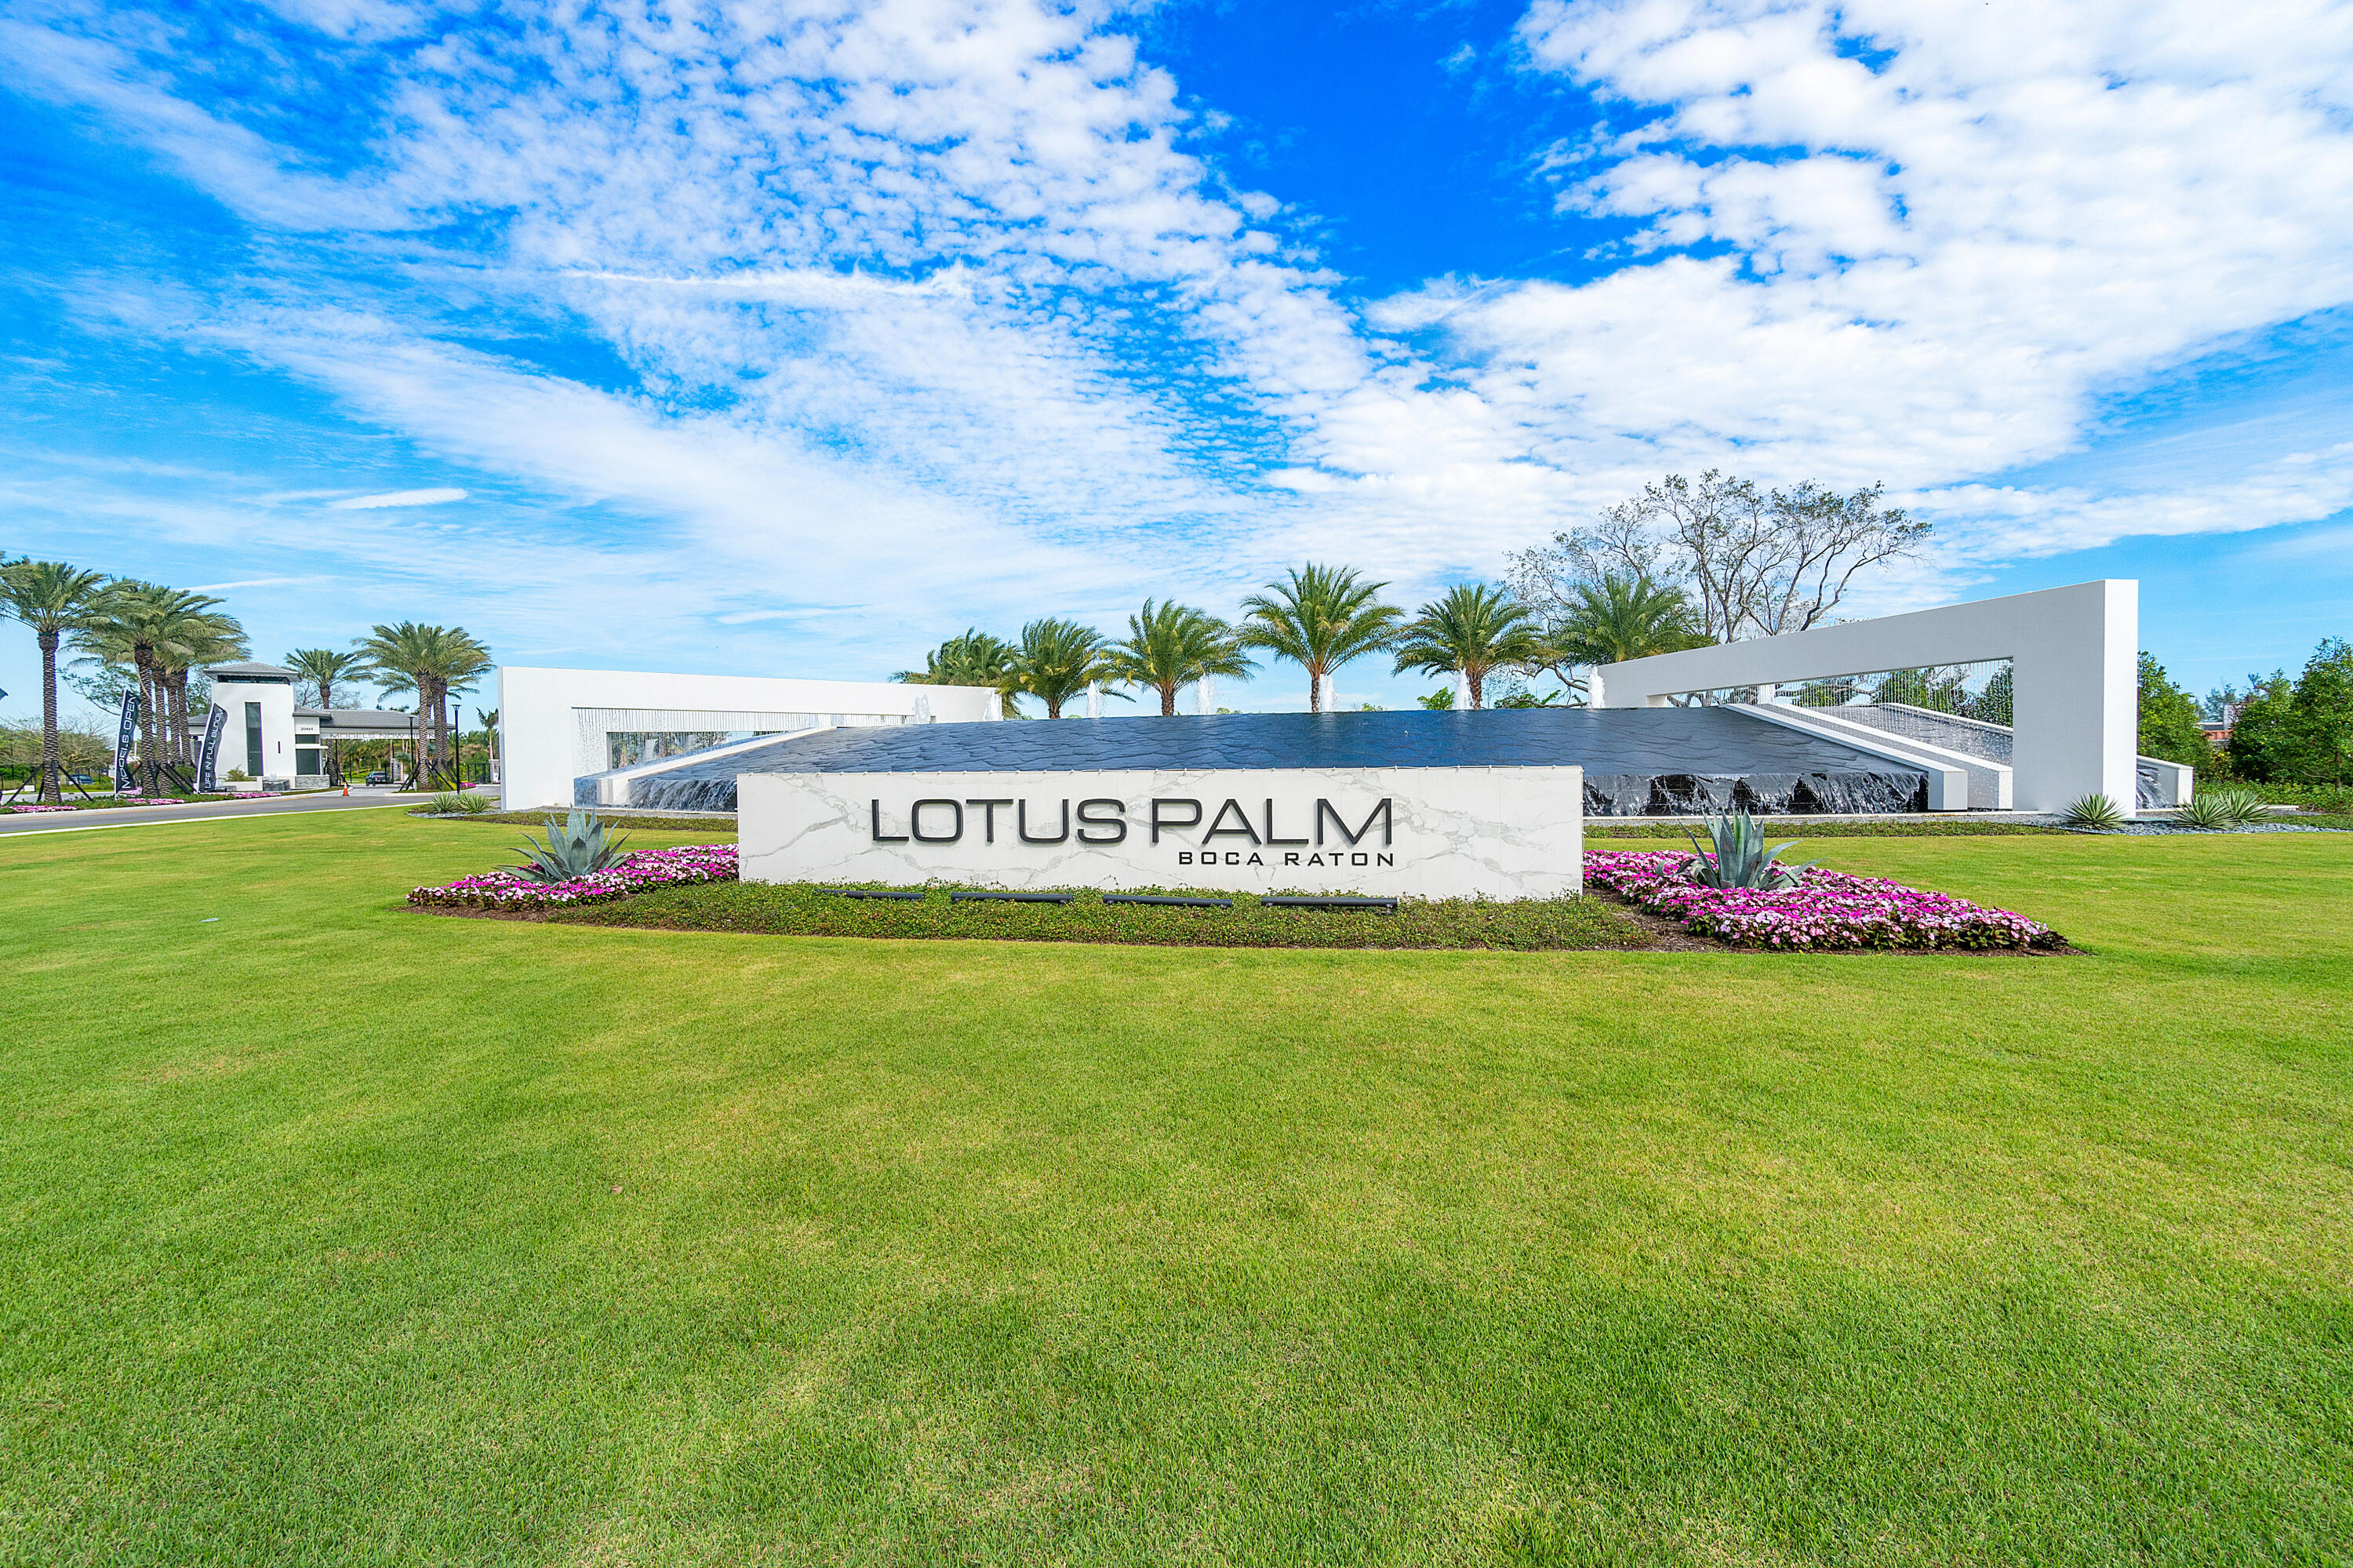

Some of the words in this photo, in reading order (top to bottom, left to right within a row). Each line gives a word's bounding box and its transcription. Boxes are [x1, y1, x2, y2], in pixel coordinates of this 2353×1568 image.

[123, 693, 136, 730] OPEN
[118, 734, 131, 789] MODELS
[205, 740, 216, 762] FULL
[205, 761, 212, 770] IN
[871, 797, 1126, 844] LOTUS
[1151, 797, 1392, 846] PALM
[1178, 851, 1264, 866] BOCA
[1284, 852, 1394, 867] RATON
